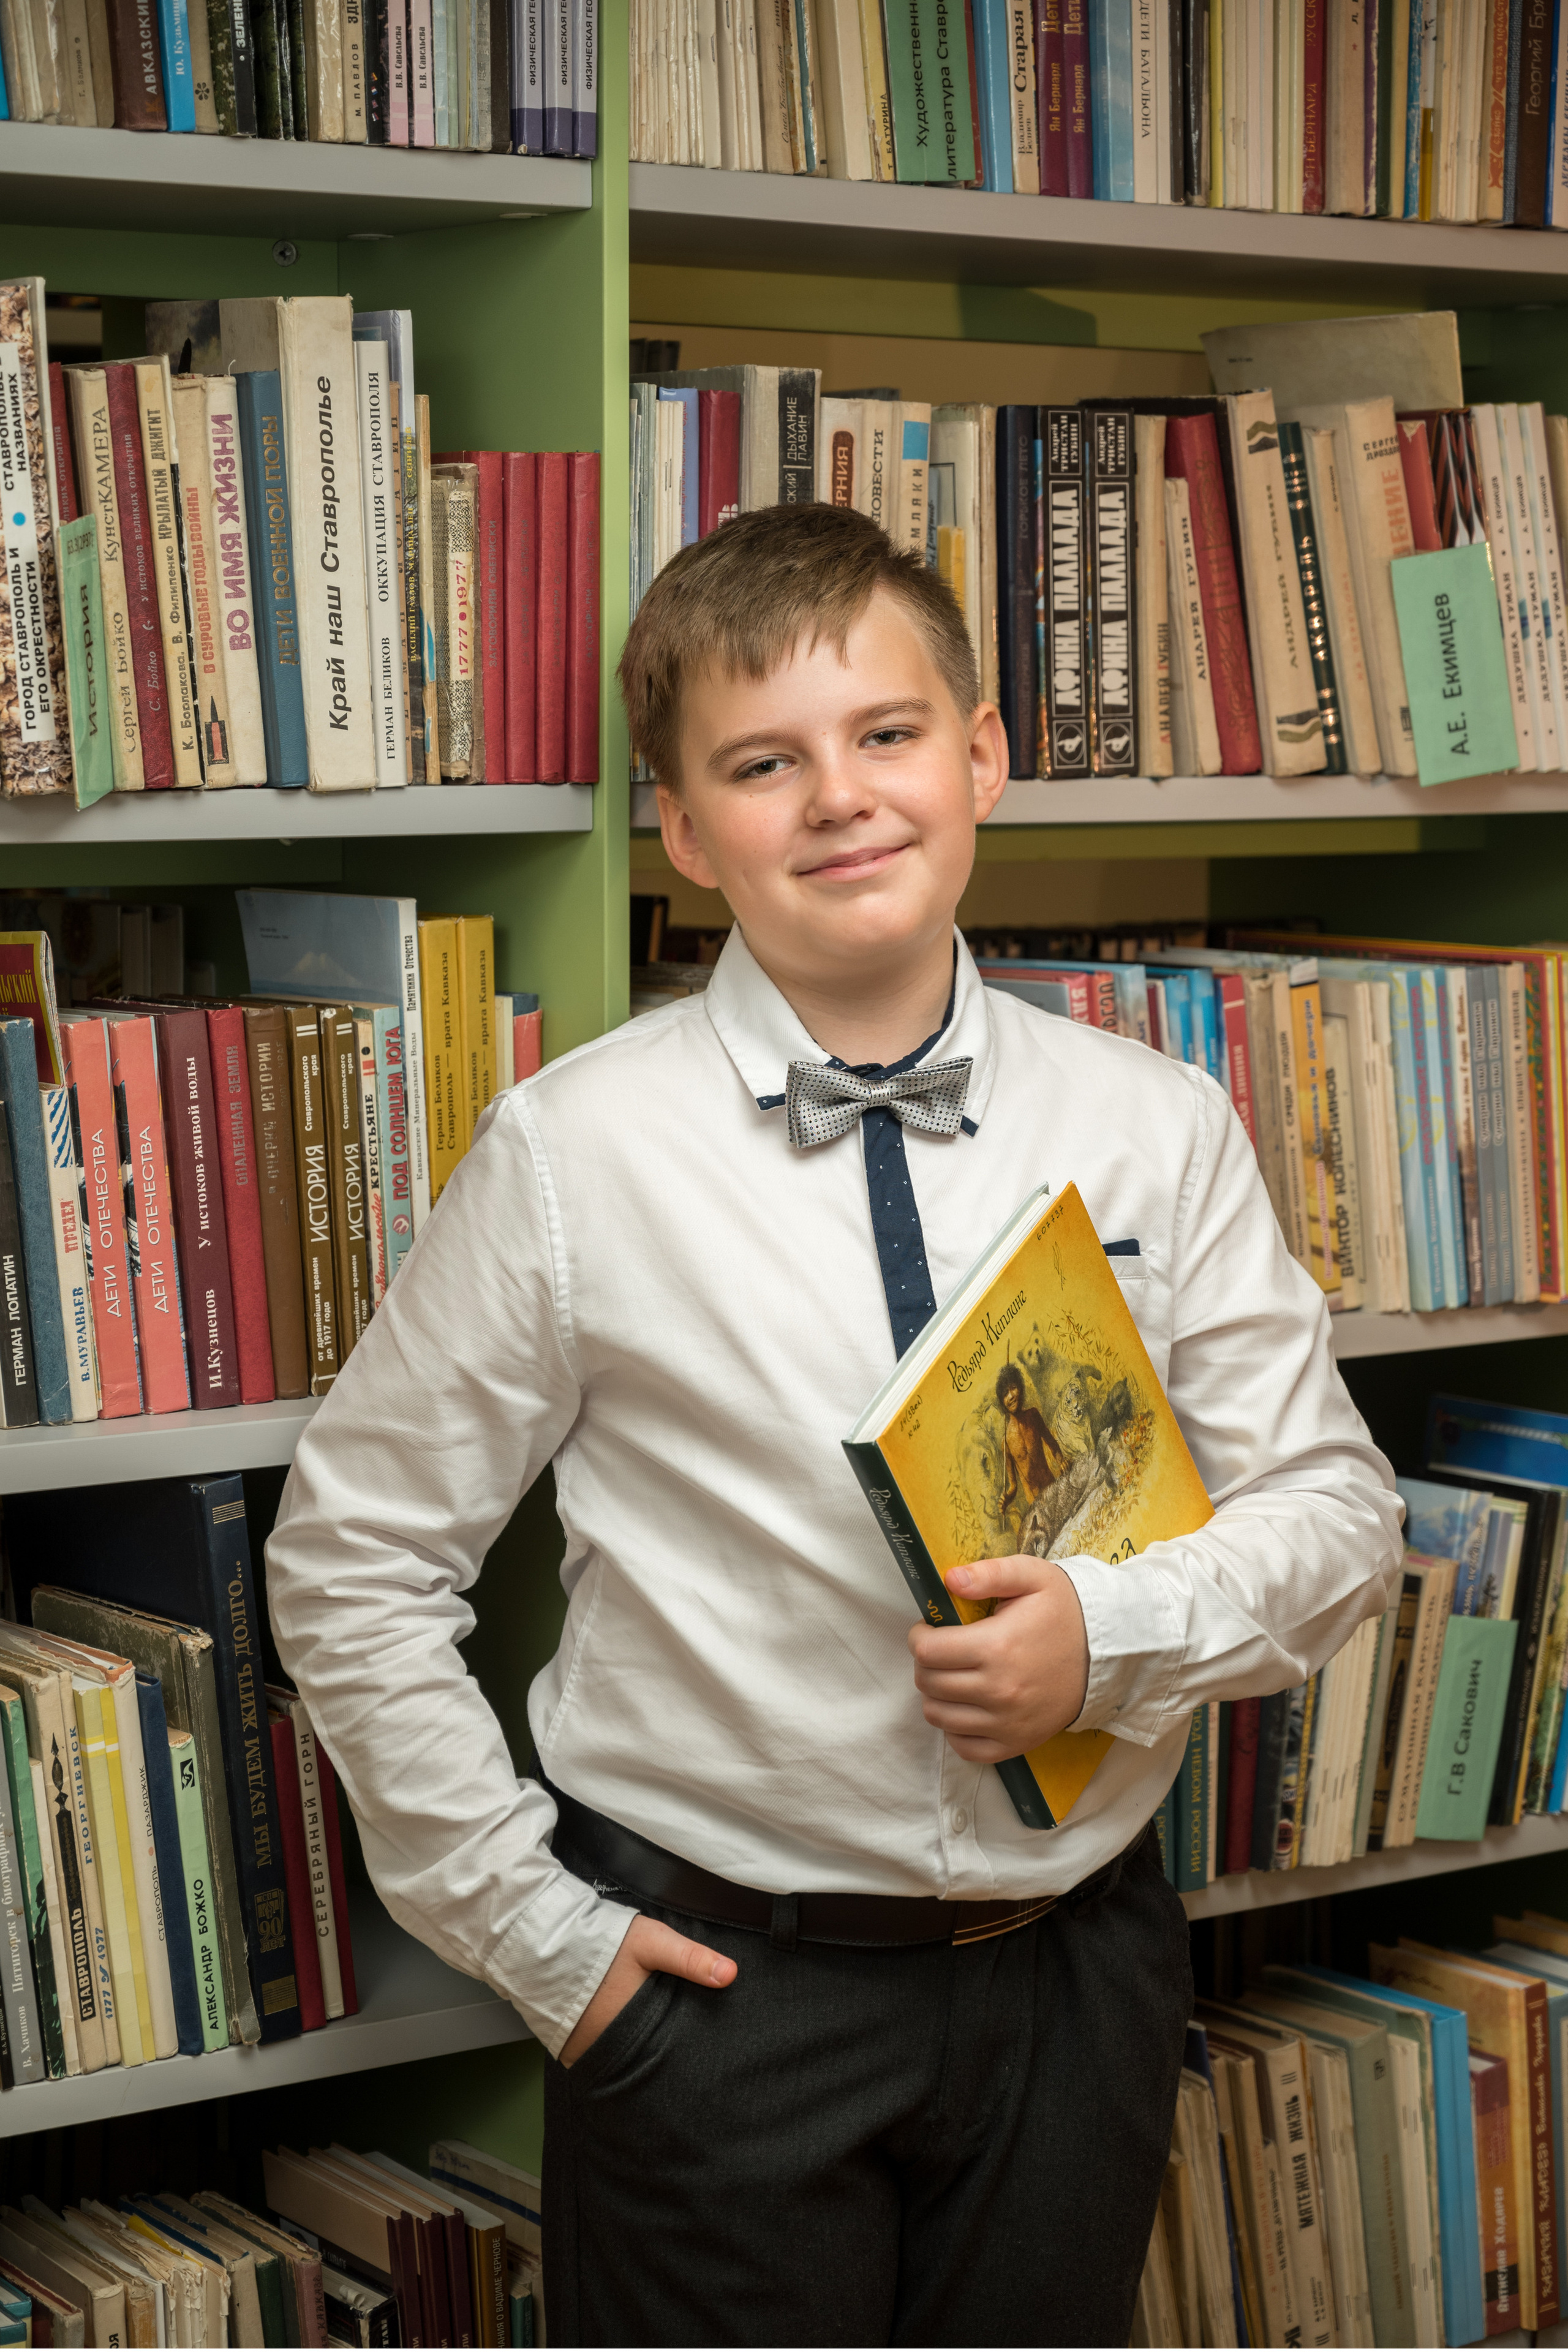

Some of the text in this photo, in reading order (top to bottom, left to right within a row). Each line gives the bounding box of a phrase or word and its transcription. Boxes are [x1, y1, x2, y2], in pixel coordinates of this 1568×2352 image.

[417, 26, 426, 70] Савельева
[528, 17, 537, 86] ФИЗИЧЕСКАЯ
[1013, 10, 1028, 92] Старая
[1141, 49, 1151, 138] БАТАЛЬОНА
[1525, 39, 1542, 115] Георгий
[940, 67, 957, 179] литература
[1049, 62, 1061, 132] Ян Бернард
[1072, 65, 1085, 134] Ян Бернард
[1306, 83, 1317, 153] БЕРНАРД
[8, 372, 26, 471] НАЗВАНИЯХ
[54, 426, 66, 481] ОТКРЫТИЙ
[786, 397, 797, 461] ДЫХАНИЕ
[797, 415, 808, 461] ЛАВИН
[1059, 415, 1069, 472] ТРИСТАН
[1069, 423, 1079, 463] ГУБИН
[1106, 417, 1115, 474] ТРИСТАН
[1117, 426, 1126, 466] ГУБИН
[124, 434, 142, 539] ВЕЛИКИХ ОТКРЫТИЙ
[147, 409, 172, 539] КРЫЛАТЫЙ ДЖИГИТ
[368, 371, 389, 602] ОККУПАЦИЯ СТАВРОПОЛЯ
[1018, 435, 1029, 539] ГОРЬКОЕ ЛЕТО
[210, 414, 252, 650] ВО ИМЯ ЖИЗНИ
[262, 416, 299, 665] ДЕТИ ВОЕННОЙ ПОРЫ
[317, 376, 352, 730] Край наш Ставрополье
[165, 546, 181, 624] Филипенко
[186, 488, 215, 674] В СУРОВЫЕ ГОДЫ ВОЙНЫ
[456, 560, 469, 675] 1777 1977
[489, 589, 497, 667] ЗАГОВОРИЛИ
[1052, 489, 1080, 706] АФИНА ПАЛЛАДА
[1098, 491, 1128, 706] АФИНА ПАЛЛАДА
[9, 548, 36, 729] ГОРОД СТАВРОПОЛЬ И
[26, 562, 50, 713] ЕГО ОКРЕСТНОСТИ
[79, 584, 97, 736] История
[147, 651, 159, 689] Бойко
[1156, 622, 1169, 670] ГУБИН
[1434, 593, 1470, 756] А.Е. Екимцев
[1510, 631, 1526, 704] ДЕДУШКА
[1535, 630, 1551, 702] ДЕДУШКА
[381, 637, 396, 760] ГЕРМАН БЕЛИКОВ
[404, 935, 417, 1011] Памятники Отечества
[225, 1045, 242, 1093] ЗЕМЛЯ
[257, 1042, 275, 1111] ИСТОРИИ
[301, 1055, 314, 1131] Ставропольского
[309, 1054, 319, 1077] края
[339, 1054, 350, 1129] Ставропольского
[345, 1052, 354, 1075] края
[440, 952, 456, 1150] Ставрополь врата Кавказа
[364, 1094, 380, 1189] КРЕСТЬЯНЕ
[385, 1026, 409, 1200] ПОД СОЛНЦЕМ ЮГА
[433, 1055, 445, 1151] Герман Беликов
[1324, 1068, 1347, 1195] КОЛЕСНИКОВ
[186, 1057, 211, 1249] У истоков живой воды
[305, 1144, 330, 1243] ИСТОРИЯ
[343, 1143, 366, 1241] ИСТОРИЯ
[91, 1128, 122, 1317] ДЕТИ ОТЕЧЕСТВА
[139, 1126, 169, 1313] ДЕТИ ОТЕЧЕСТВА
[1335, 1205, 1355, 1277] ВИКТОР
[311, 1257, 324, 1361] от древнейших времен
[350, 1254, 360, 1287] времен
[2, 1254, 27, 1386] ГЕРМАН ЛОПАТИН
[72, 1286, 91, 1382] В.МУРАВЬЕВ
[205, 1289, 223, 1389] И.Кузнецов
[323, 1325, 332, 1346] 1917
[325, 1348, 333, 1360] до
[947, 1289, 1028, 1393] Редьярд Киплинг
[238, 1663, 272, 1868] МЫ БУДЕМ ЖИТЬ
[1447, 1657, 1484, 1796] Г.В Сакович
[69, 1725, 92, 1865] ГЕОРГИЕВСК
[300, 1733, 330, 1937] СЕРЕБРЯНЫЙ ГОРН
[1190, 1809, 1202, 1872] РОССИИ
[138, 1765, 165, 1941] СТАВРОПОЛЬ ПАЗАРДЖИК
[6, 1908, 24, 1994] Пятигорск в
[71, 1907, 93, 2018] СТАВРОПОЛЬ
[192, 1879, 219, 2030] АЛЕКСАНДР БОЖКО
[17, 2005, 32, 2068] В. Хачиков
[1284, 2095, 1315, 2229] МЯТЕЖНАЯ ЖИЗНЬ
[492, 2237, 503, 2312] ВАДИМЕ ЧЕРНОВЕ
